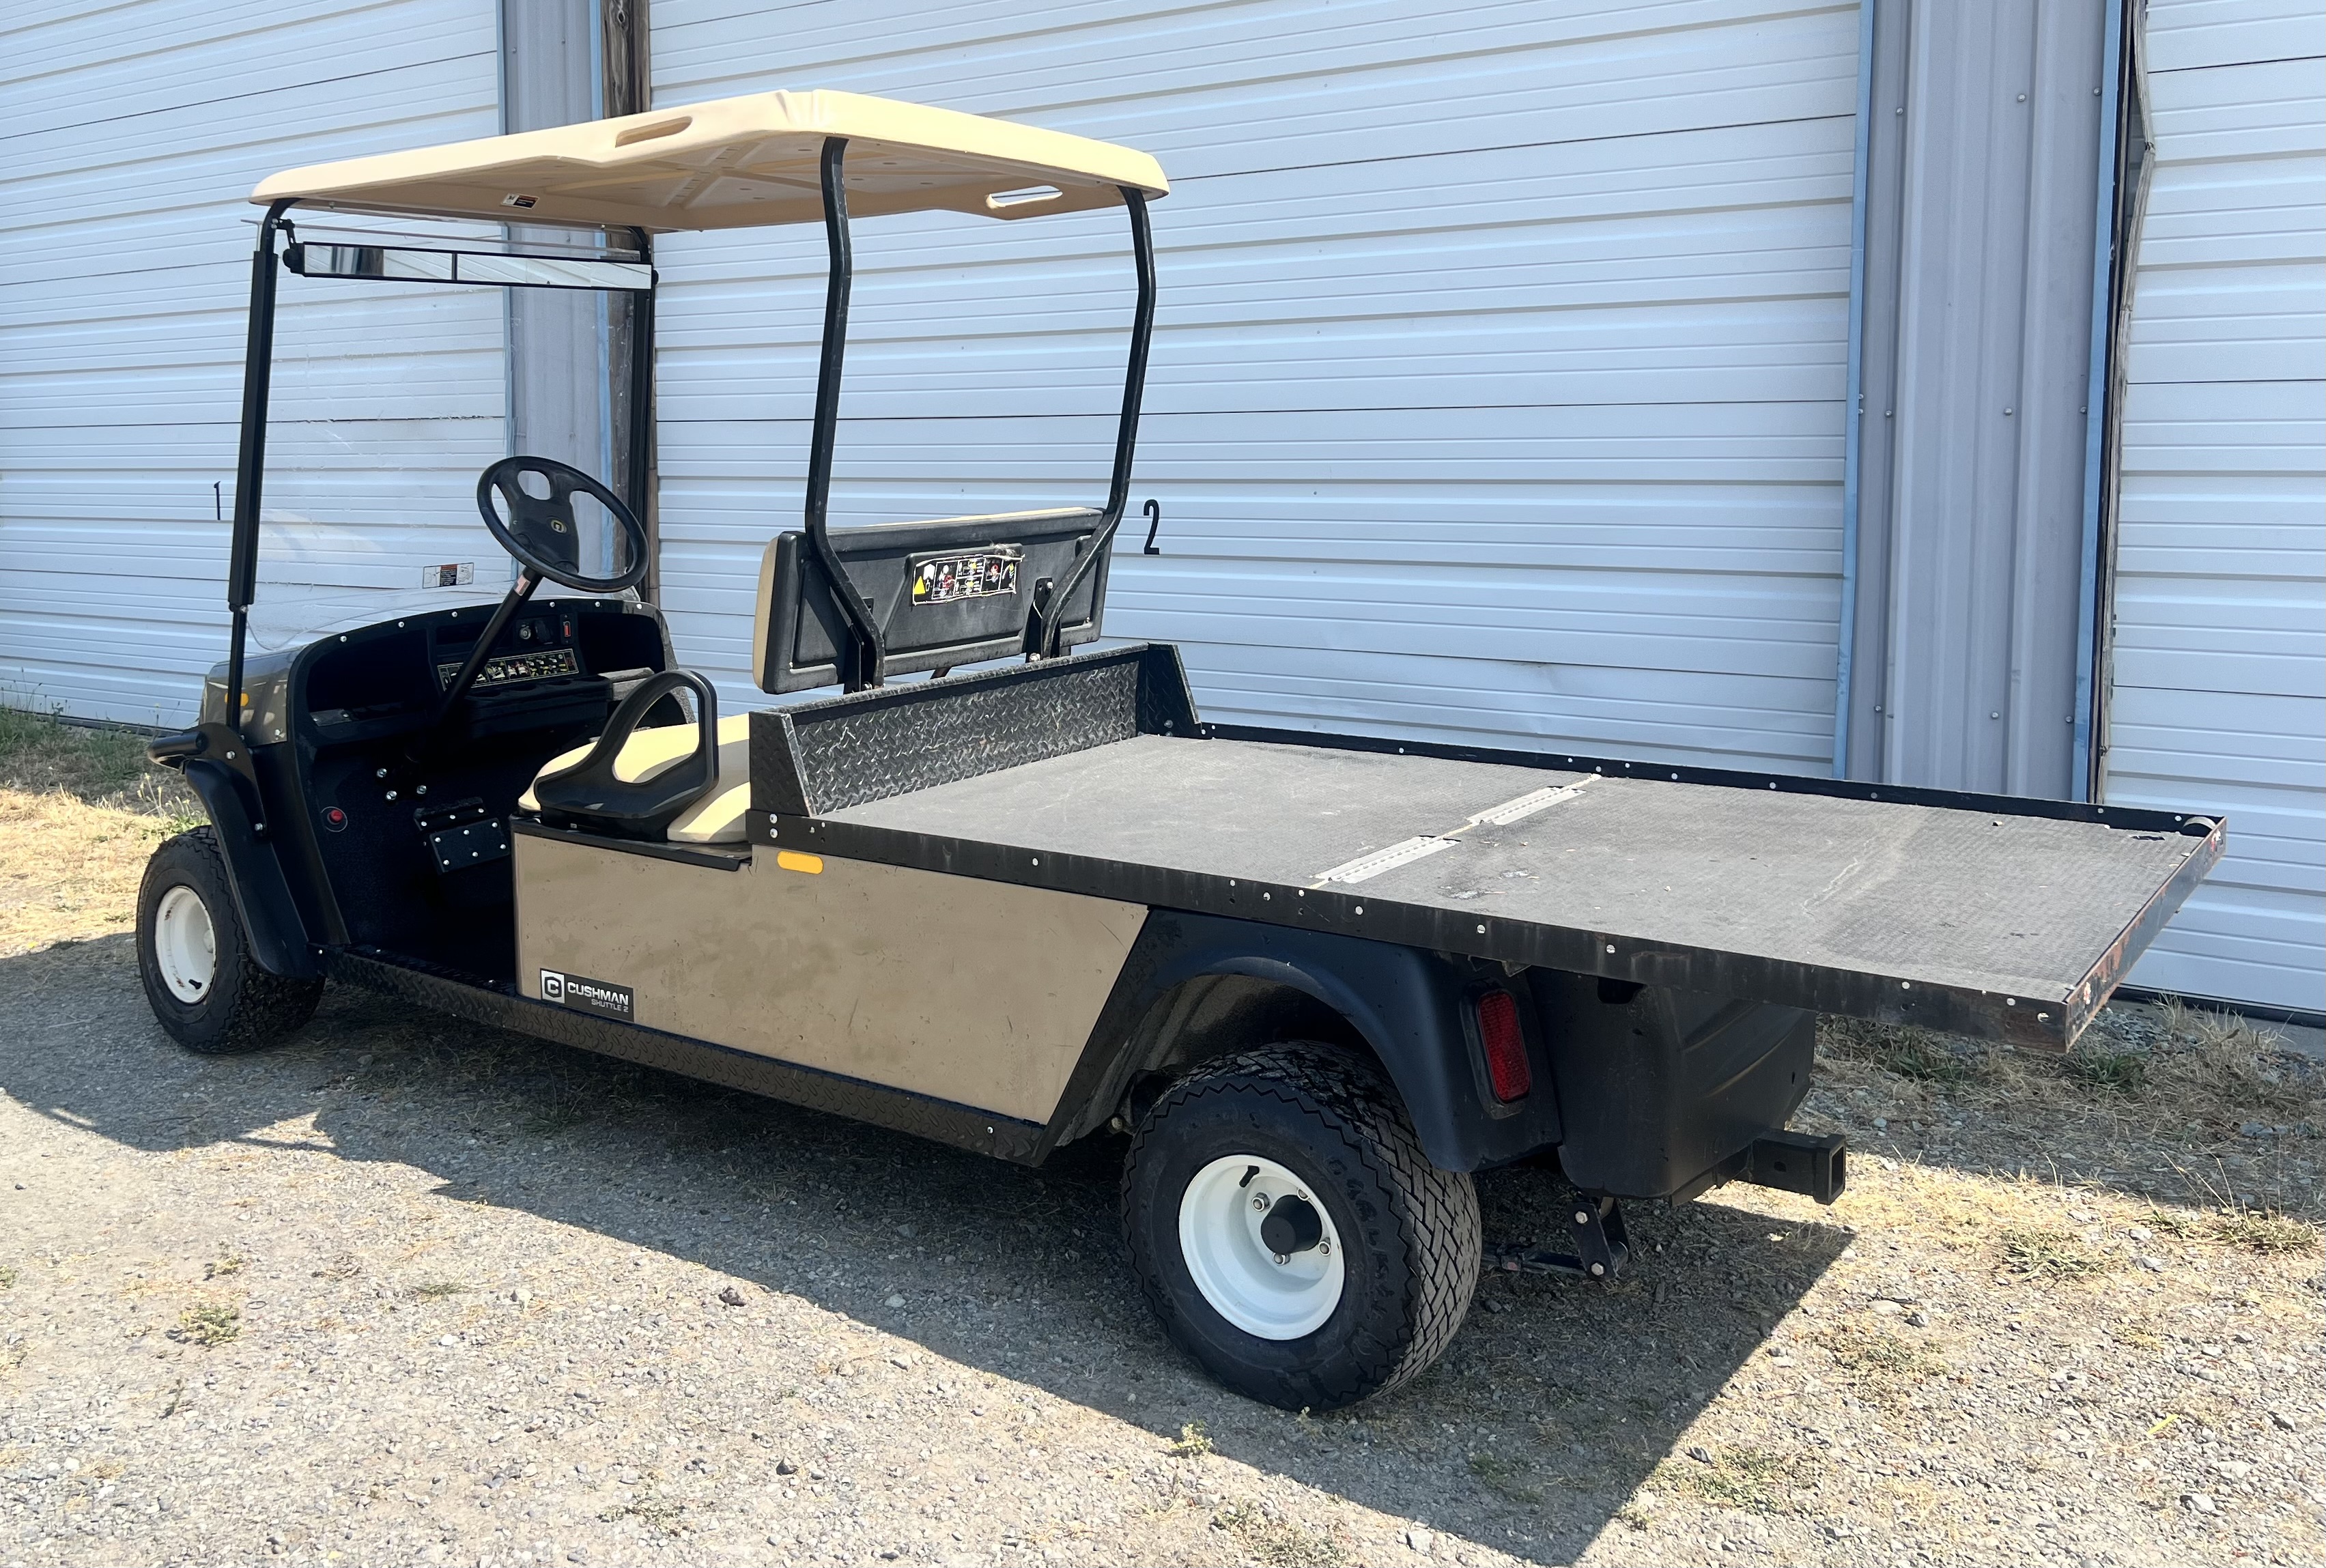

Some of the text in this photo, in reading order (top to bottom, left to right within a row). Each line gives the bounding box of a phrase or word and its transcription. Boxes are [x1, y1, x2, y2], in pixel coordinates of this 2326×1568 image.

[213, 481, 221, 520] 1
[1144, 499, 1160, 555] 2
[567, 982, 629, 1006] CUSHMAN
[591, 998, 622, 1012] SHUTTLE
